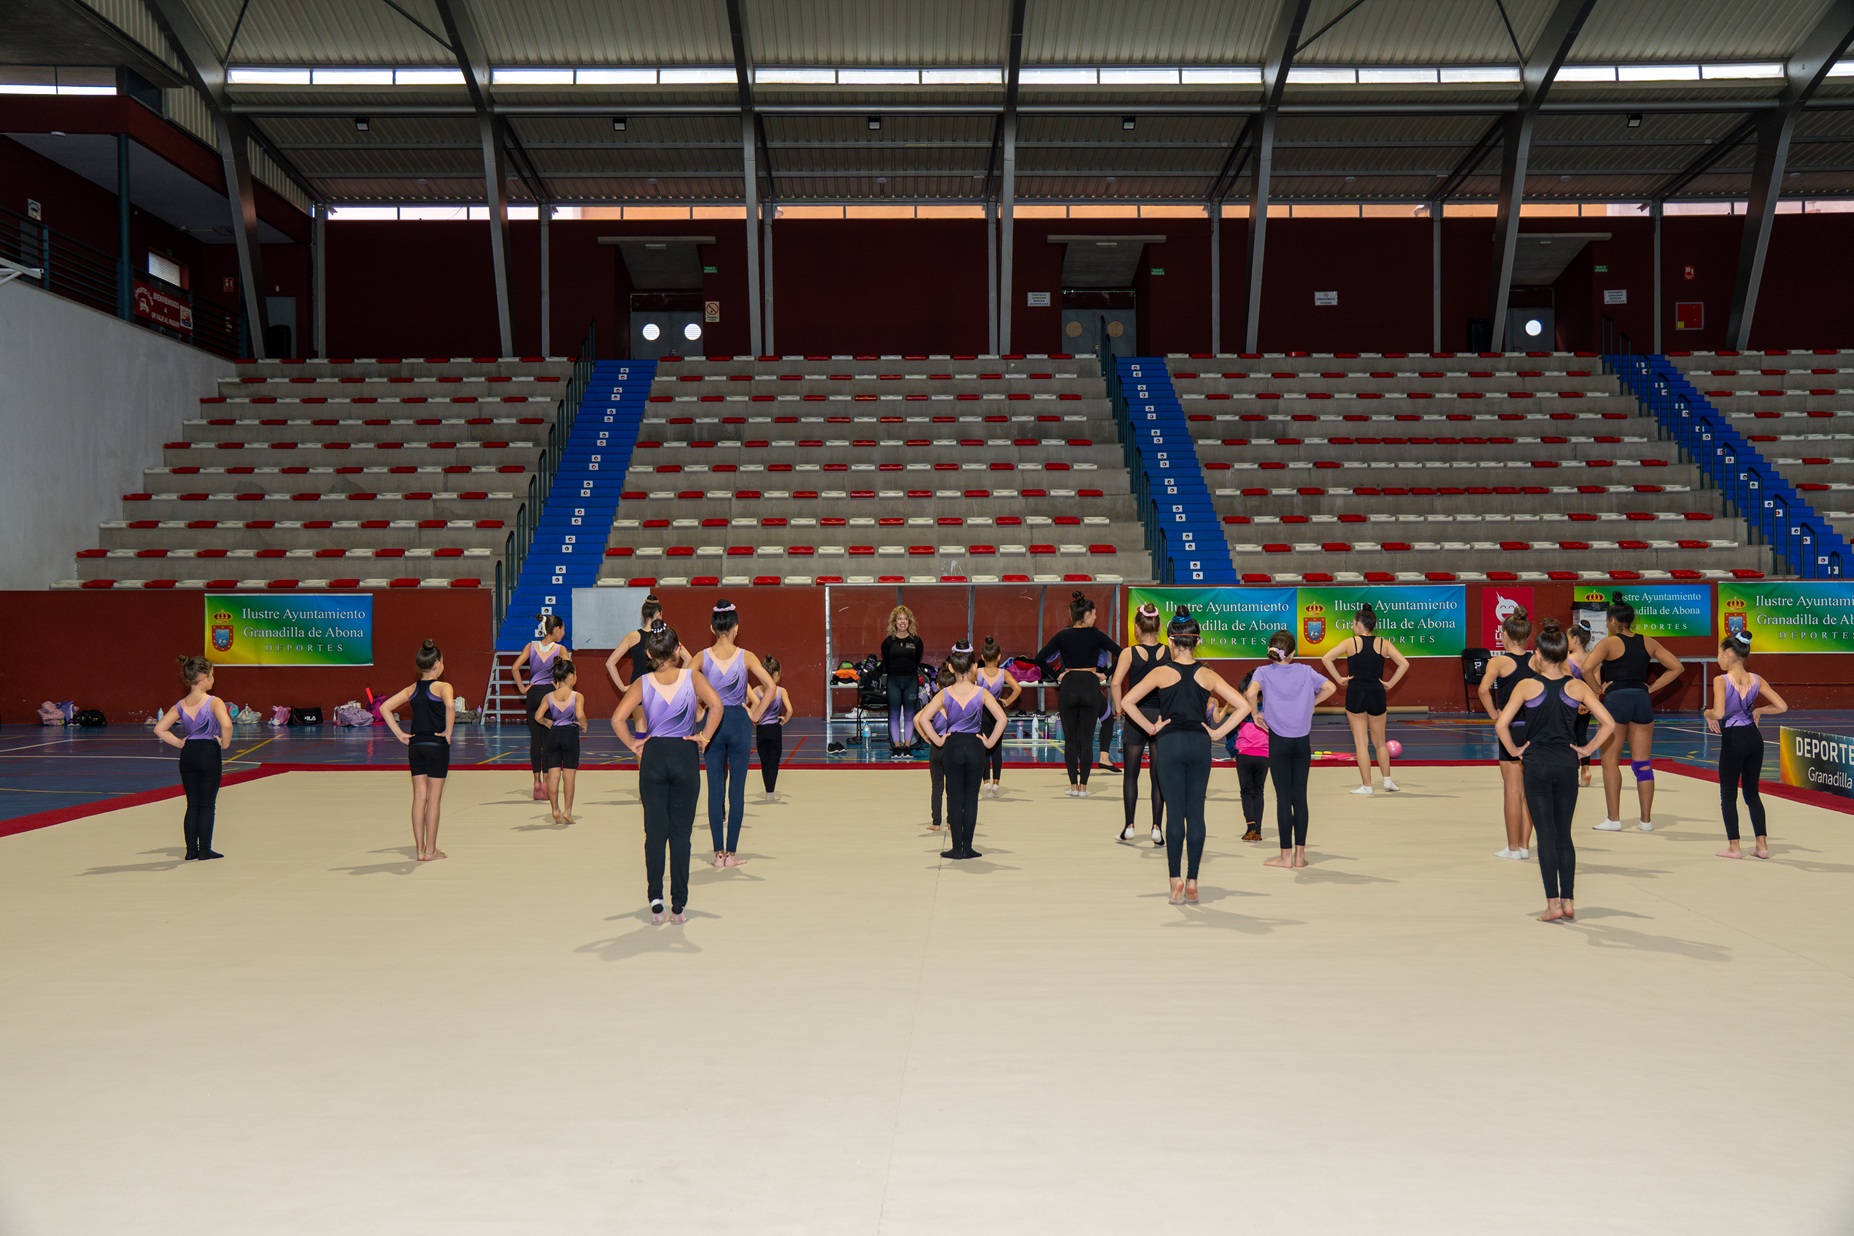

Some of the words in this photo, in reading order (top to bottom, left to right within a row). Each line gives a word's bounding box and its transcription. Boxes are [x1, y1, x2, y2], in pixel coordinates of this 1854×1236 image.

[1641, 592, 1702, 603] Ayuntamiento
[1756, 595, 1793, 606] Ilustre
[1165, 601, 1203, 612] Iltre
[1206, 601, 1289, 615] Ayuntamiento
[1374, 599, 1457, 613] Ayuntamiento
[1660, 606, 1670, 615] de
[1672, 606, 1700, 615] Abona
[242, 608, 280, 619] Ilustre
[283, 608, 366, 622] Ayuntamiento
[1756, 614, 1819, 625] Granadilla
[1822, 614, 1837, 625] de
[1231, 620, 1246, 631] de
[1249, 620, 1287, 631] Abona
[1400, 618, 1414, 629] de
[1417, 618, 1456, 629] Abona
[243, 627, 305, 638] Granadilla
[308, 627, 322, 638] de
[325, 627, 364, 638] Abona
[1200, 637, 1267, 645] EPORTES
[265, 644, 344, 652] DEPORTES
[1808, 766, 1853, 789] Granadilla
